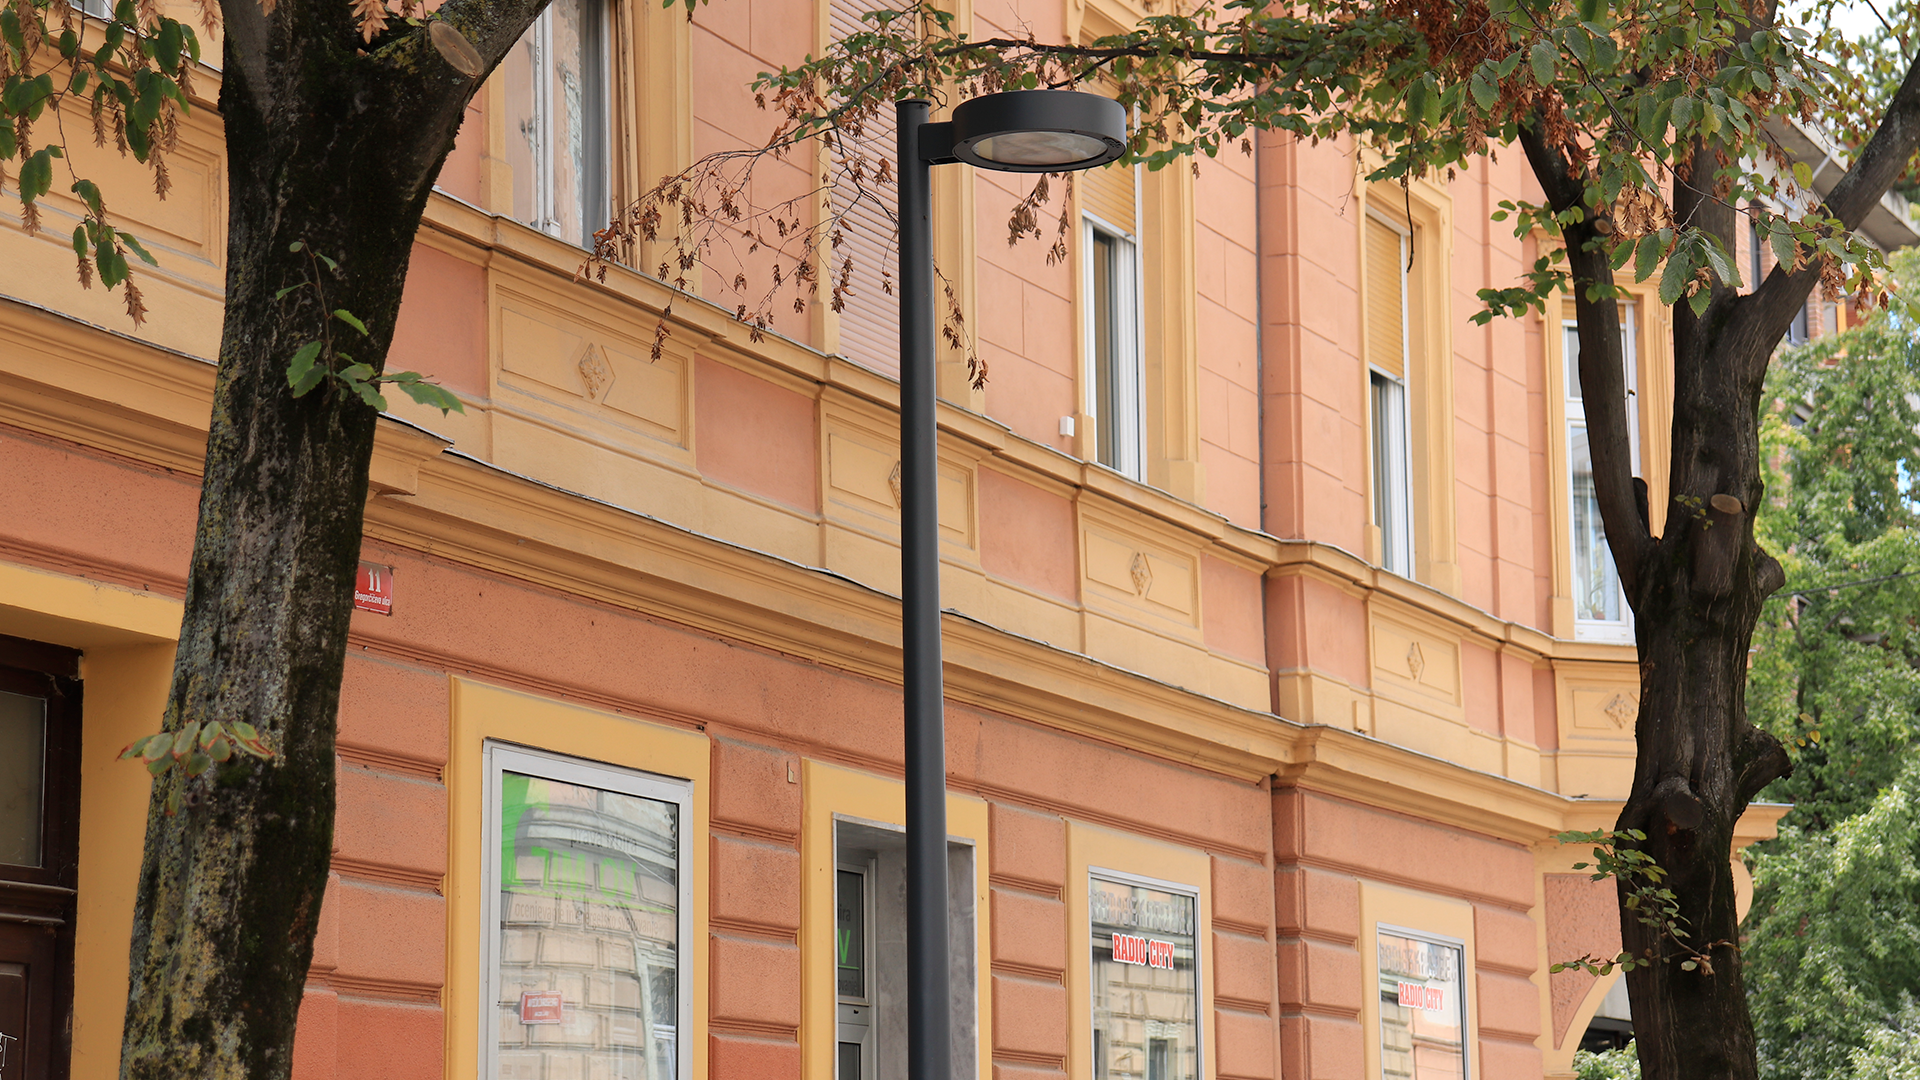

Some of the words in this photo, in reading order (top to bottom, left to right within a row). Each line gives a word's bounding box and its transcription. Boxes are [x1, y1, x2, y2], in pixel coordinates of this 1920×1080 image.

[368, 568, 381, 593] 11
[570, 826, 603, 848] prava
[514, 900, 565, 923] ocenjevanje
[566, 904, 574, 922] in
[1113, 934, 1146, 964] RADIO
[1149, 939, 1175, 969] CITY
[1398, 982, 1423, 1008] RADIO
[1425, 986, 1444, 1011] CITY
